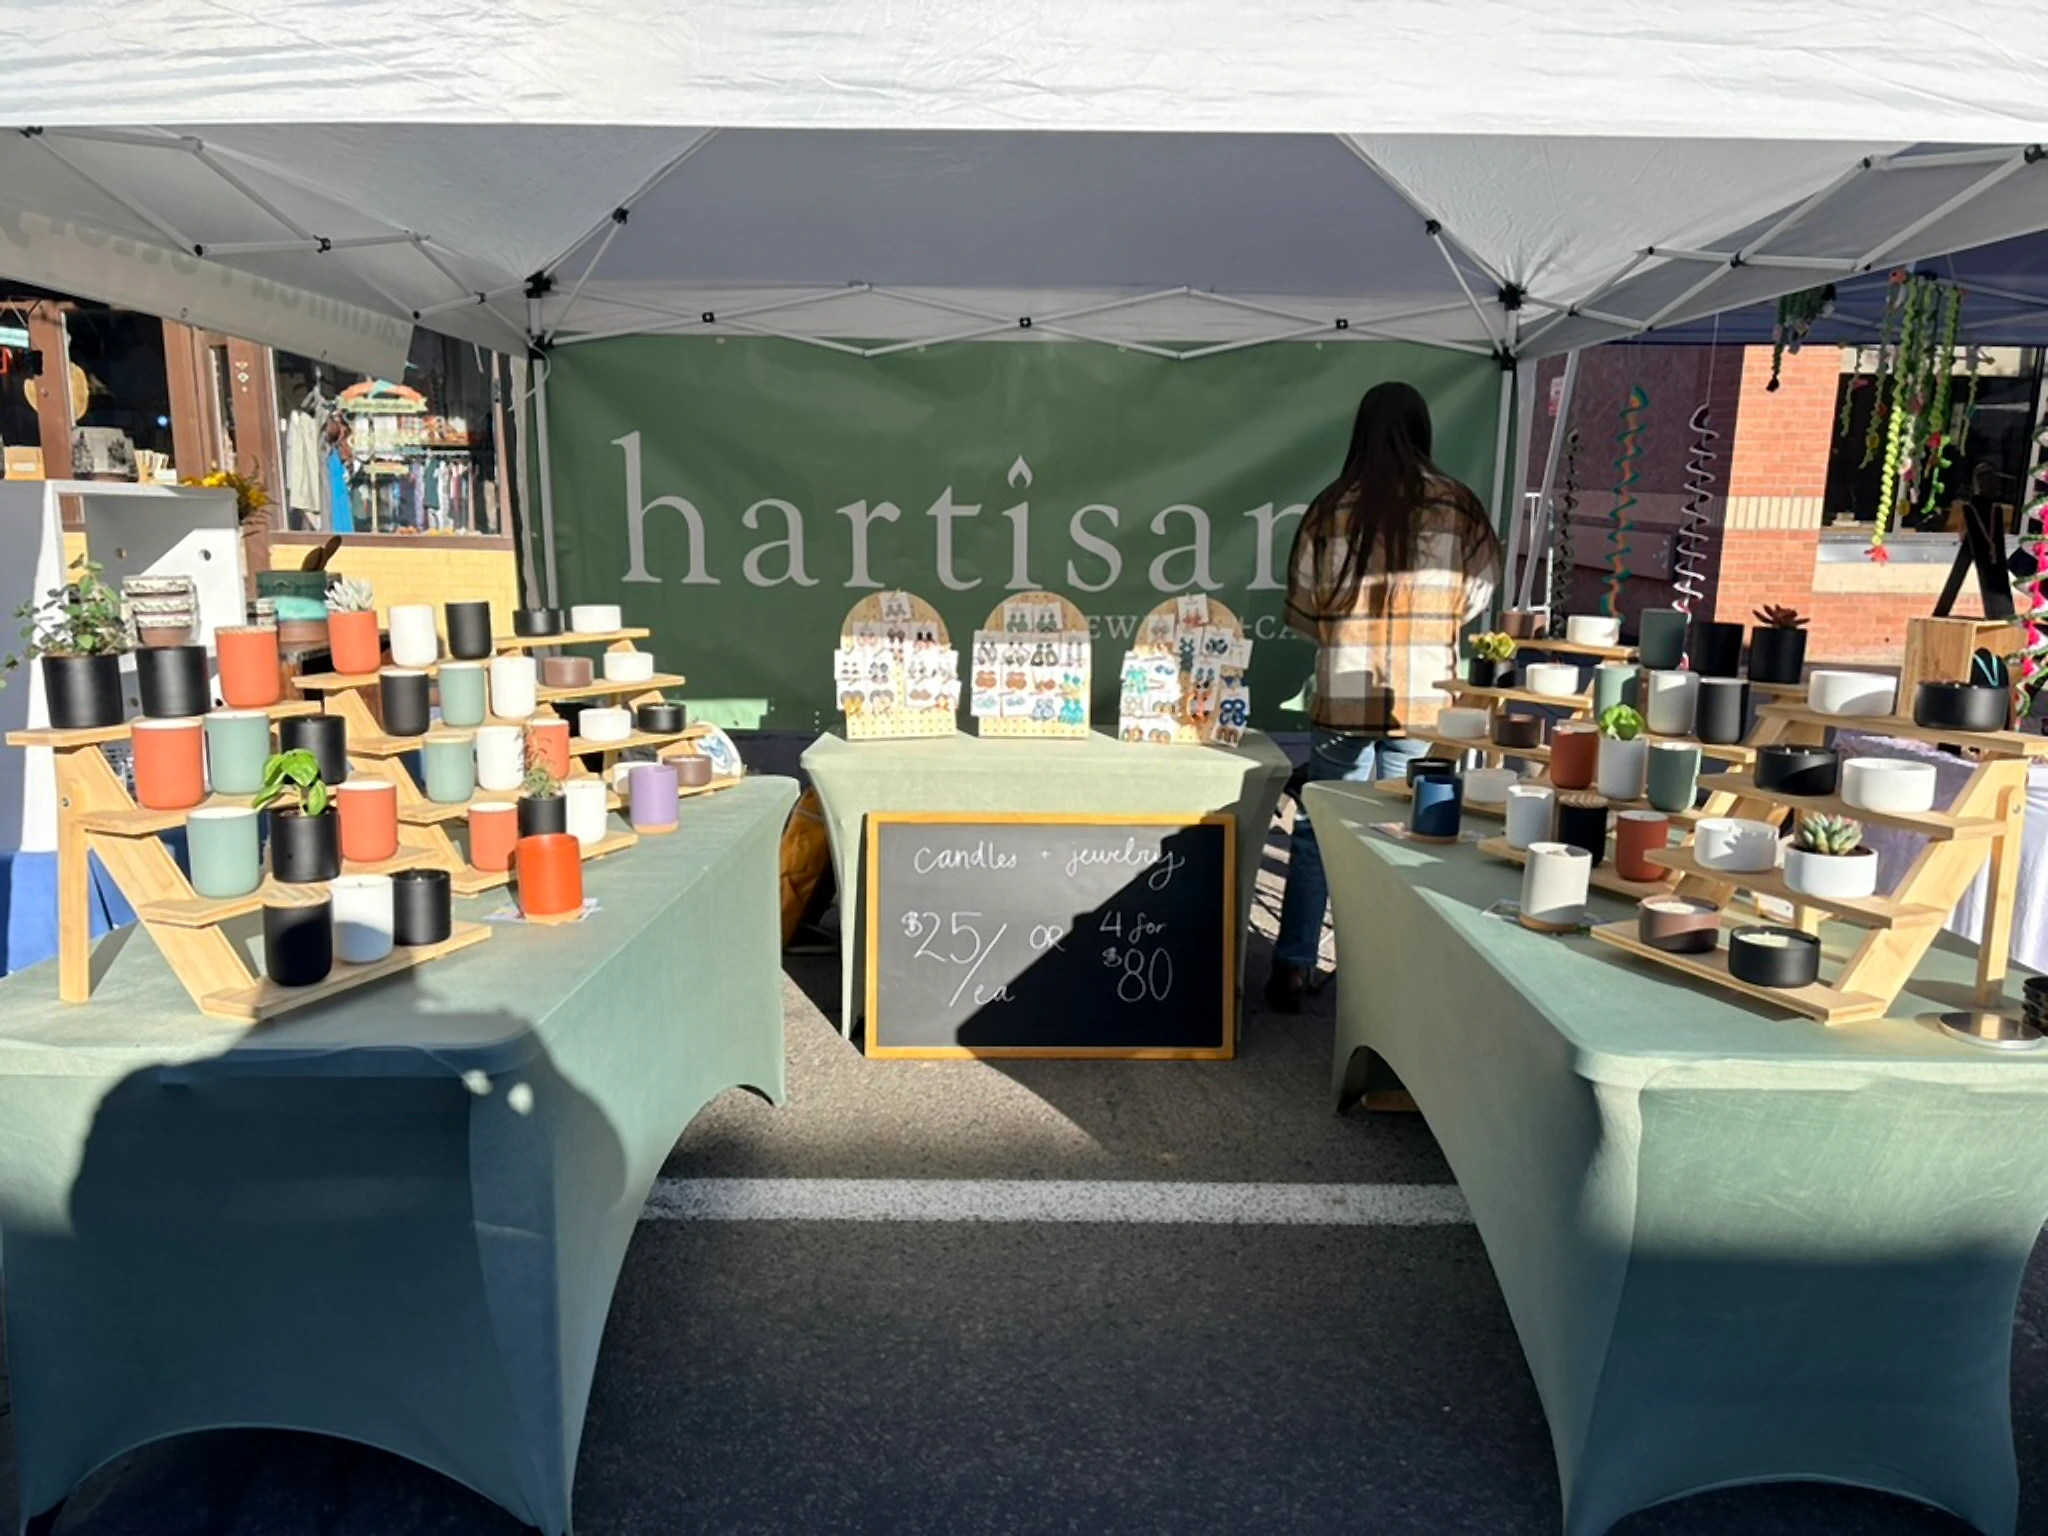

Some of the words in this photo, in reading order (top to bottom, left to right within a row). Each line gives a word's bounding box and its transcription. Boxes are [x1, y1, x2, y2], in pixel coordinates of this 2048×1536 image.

[914, 841, 1017, 874] candles
[1065, 837, 1185, 890] jewelry
[1029, 924, 1066, 952] OR
[1099, 911, 1122, 938] 4
[1128, 911, 1168, 945] for
[1102, 946, 1174, 1003] $80
